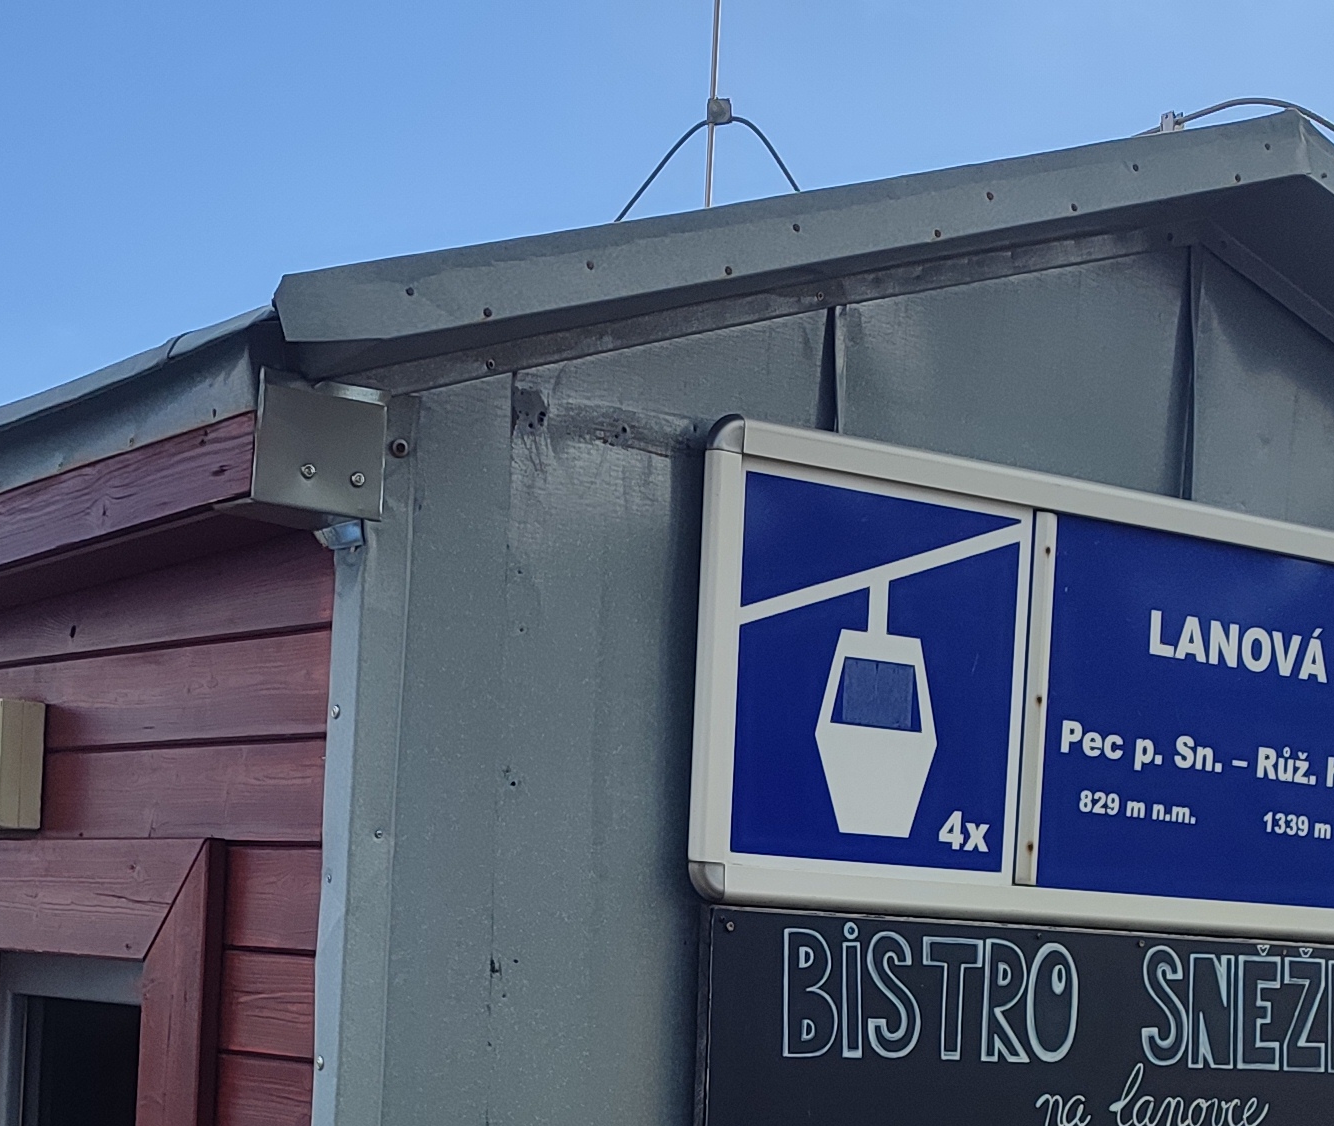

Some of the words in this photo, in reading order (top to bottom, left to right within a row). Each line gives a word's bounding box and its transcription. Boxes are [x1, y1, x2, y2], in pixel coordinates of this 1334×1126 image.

[1149, 609, 1327, 684] LANOVÁ
[1060, 719, 1124, 760] Pec
[1134, 738, 1163, 771] p.
[1174, 735, 1223, 773] Sn.
[1256, 746, 1317, 786] Růž.
[1079, 790, 1120, 815] 829
[1125, 801, 1146, 819] m
[1151, 803, 1196, 825] n.m.
[1263, 811, 1309, 837] 1339
[1314, 822, 1331, 839] m
[938, 810, 990, 853] 4x
